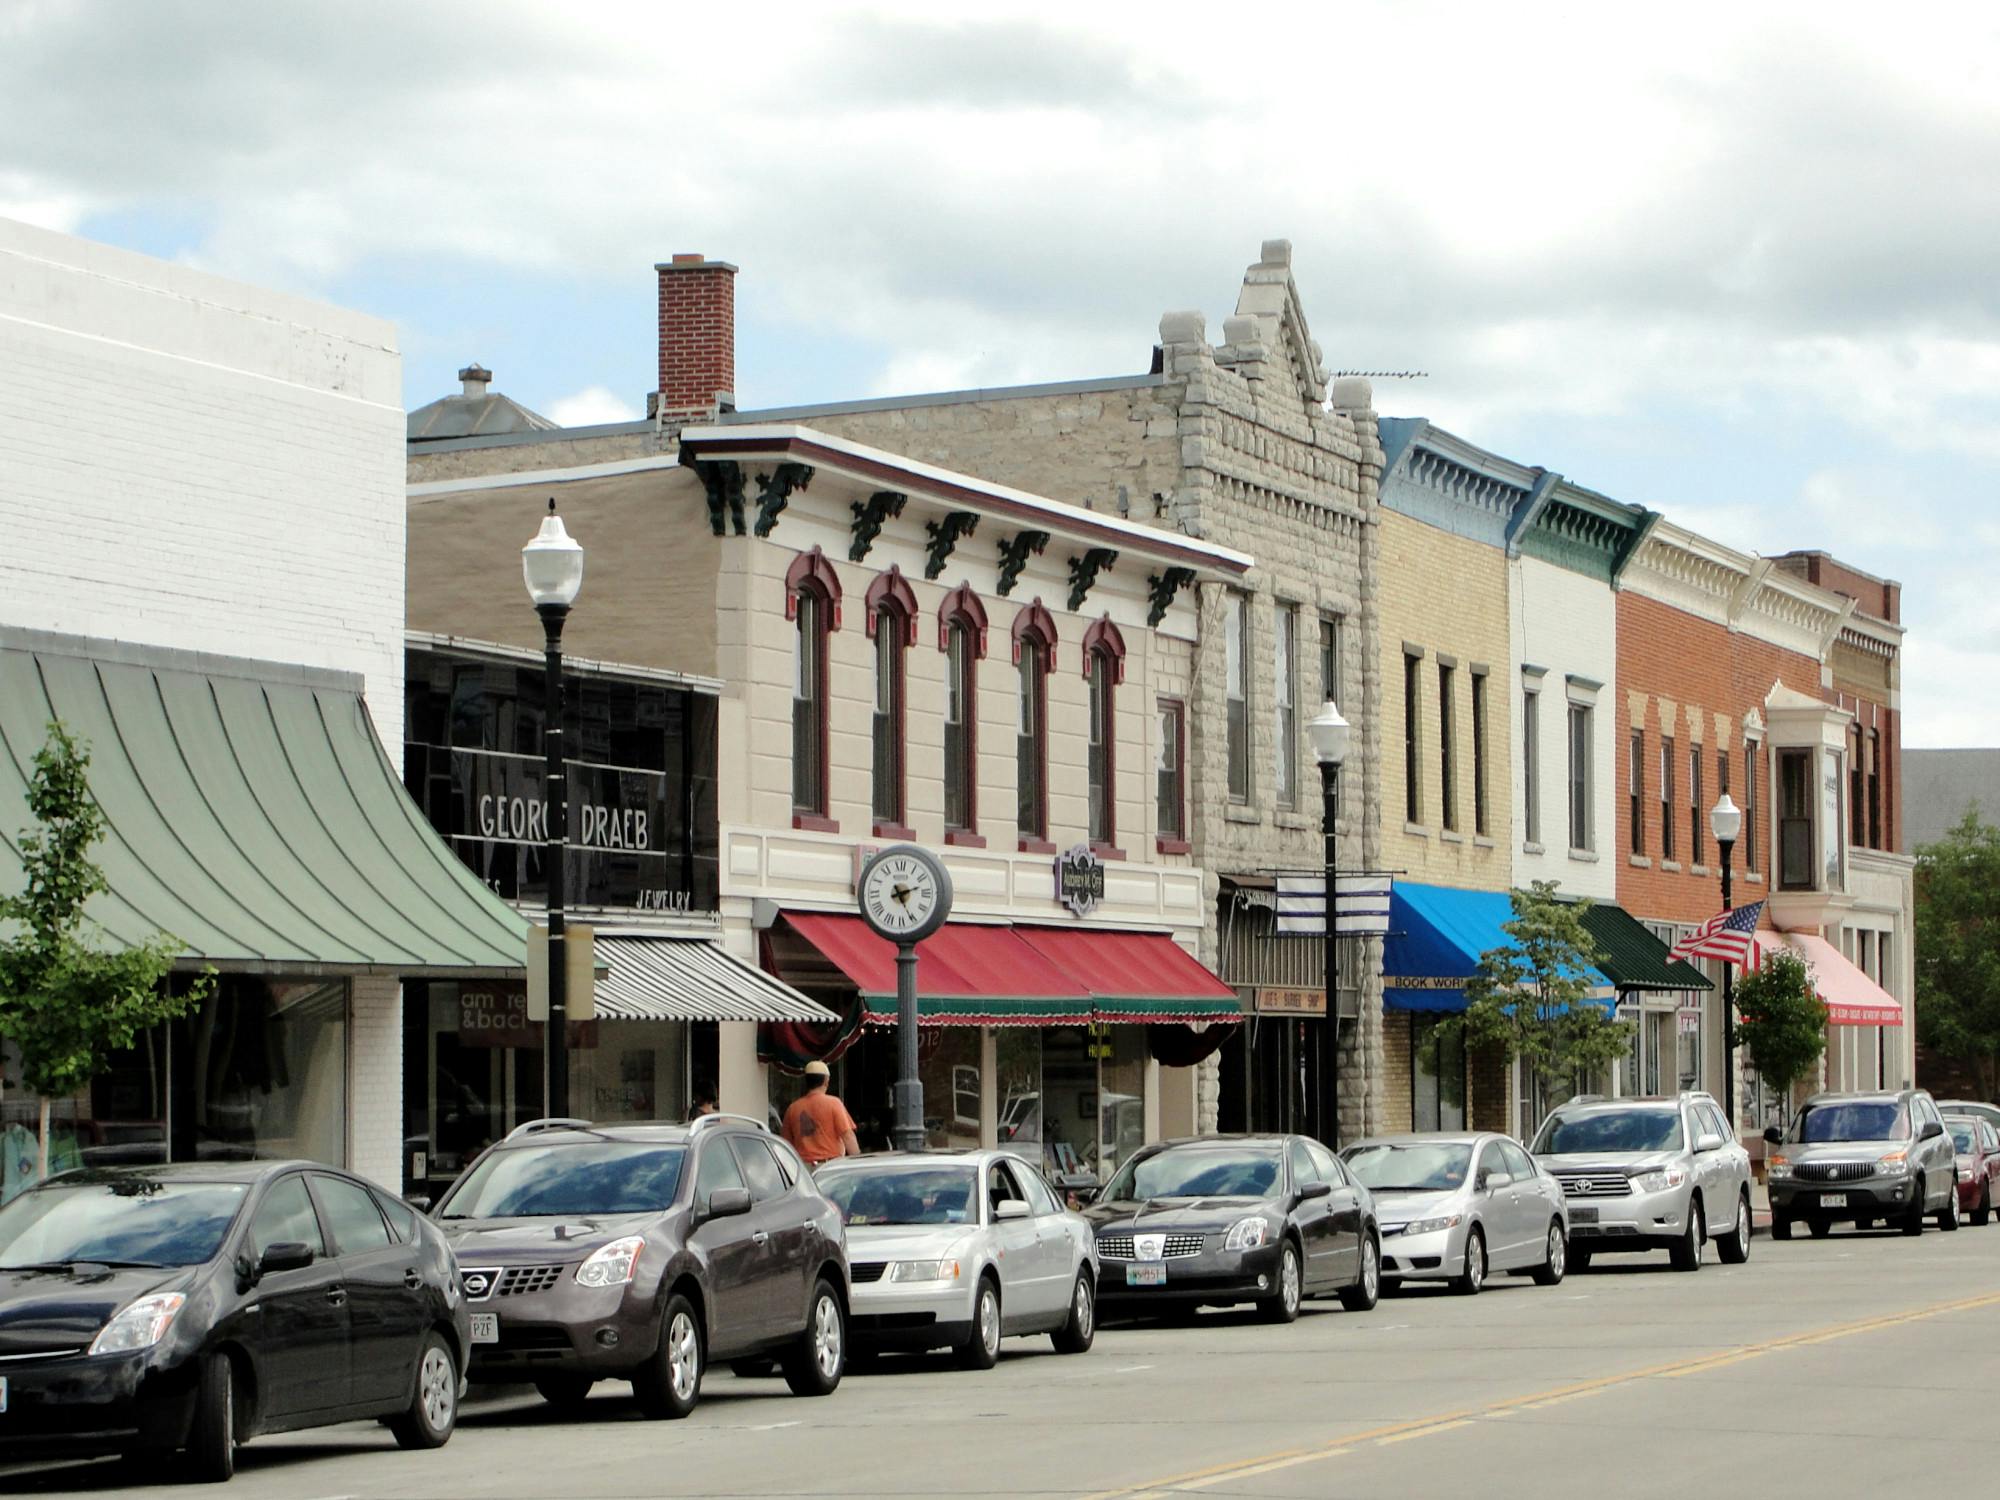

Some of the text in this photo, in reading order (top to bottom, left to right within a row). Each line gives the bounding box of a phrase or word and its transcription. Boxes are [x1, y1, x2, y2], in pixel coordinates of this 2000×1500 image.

[479, 794, 648, 850] GEOR DRAEB
[636, 889, 691, 911] JEWELRY
[1395, 977, 1464, 988] BOOK WOR
